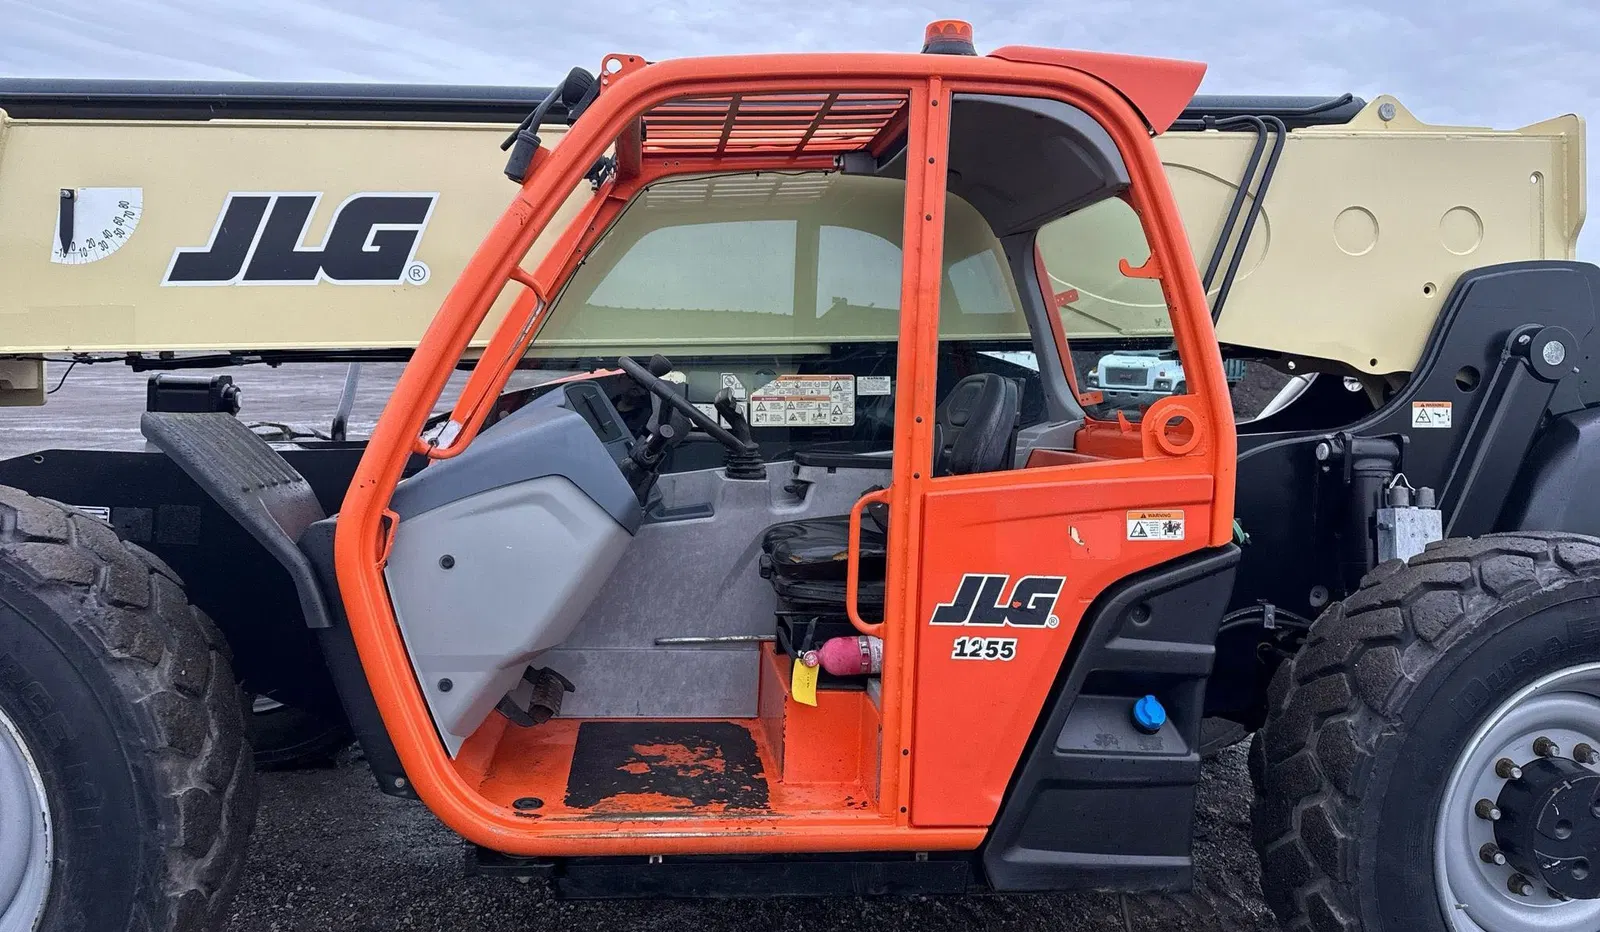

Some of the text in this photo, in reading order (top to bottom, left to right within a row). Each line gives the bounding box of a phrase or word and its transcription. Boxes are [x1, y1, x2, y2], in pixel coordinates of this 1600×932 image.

[118, 200, 130, 209] 80
[123, 210, 135, 220] 70
[113, 216, 125, 226] 60
[102, 229, 113, 240] 40
[113, 227, 125, 238] 50
[86, 238, 96, 249] 20
[167, 196, 434, 282] JLG
[71, 241, 76, 251] 0
[98, 240, 109, 251] 30
[79, 247, 88, 257] 10
[932, 575, 1064, 626] JLG
[954, 639, 1015, 659] 1255
